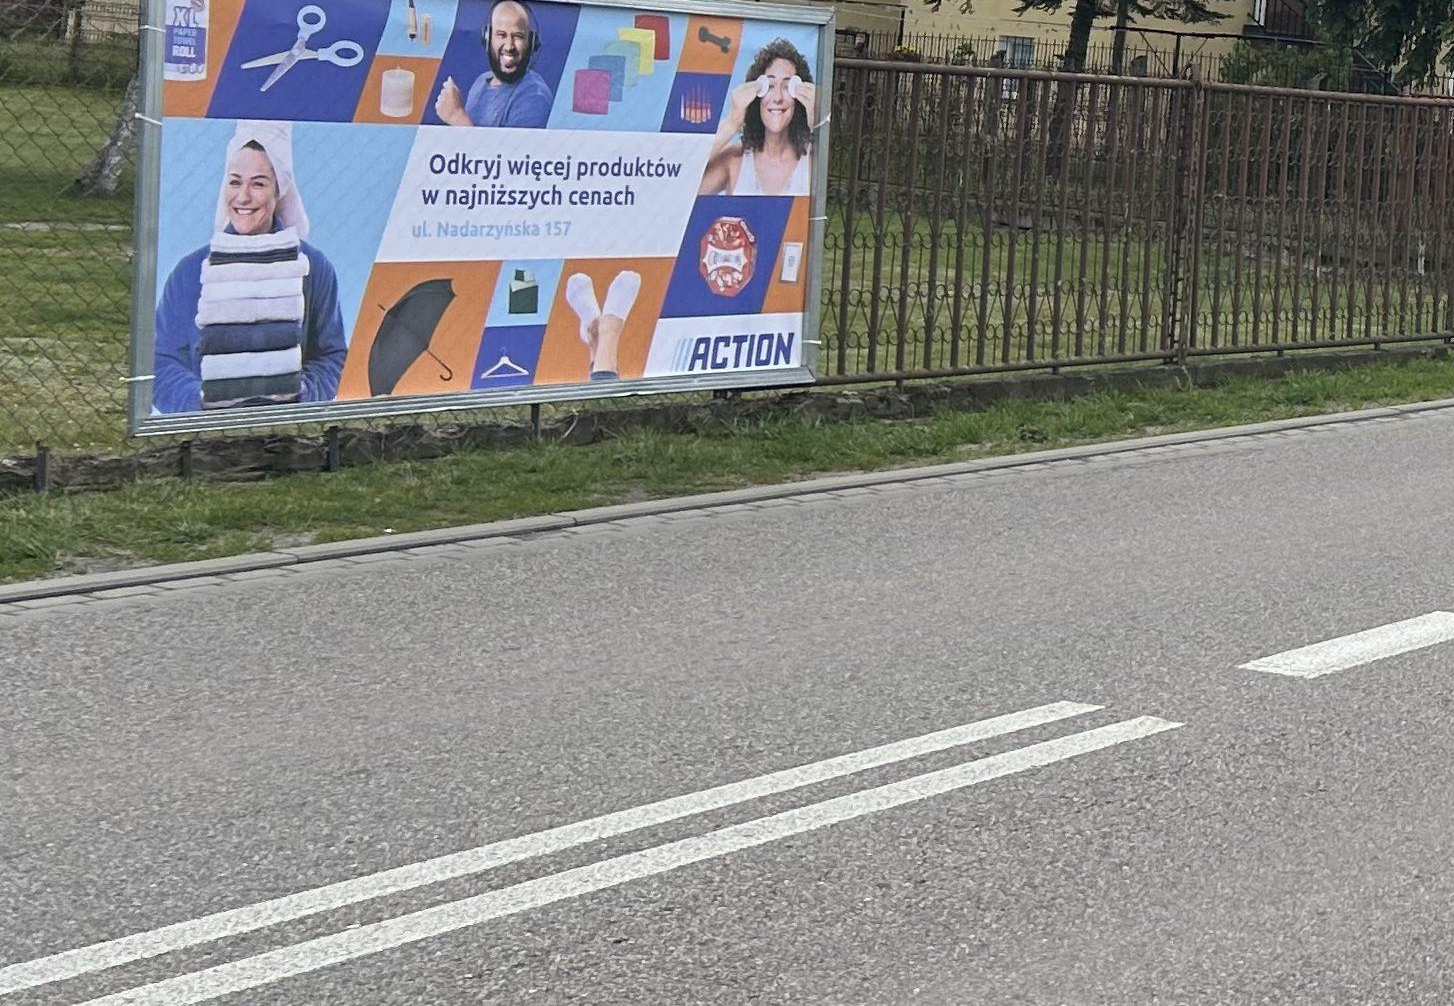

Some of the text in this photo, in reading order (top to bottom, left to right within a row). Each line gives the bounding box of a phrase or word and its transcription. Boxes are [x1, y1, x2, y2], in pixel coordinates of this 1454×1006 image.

[173, 6, 199, 27] XL
[172, 45, 197, 58] ROLL
[429, 152, 682, 182] Odkryj więcej produktów
[422, 183, 635, 210] w najniższych cenach
[411, 219, 572, 240] ul. Nadarzyńska 157
[687, 332, 795, 372] ACTION
